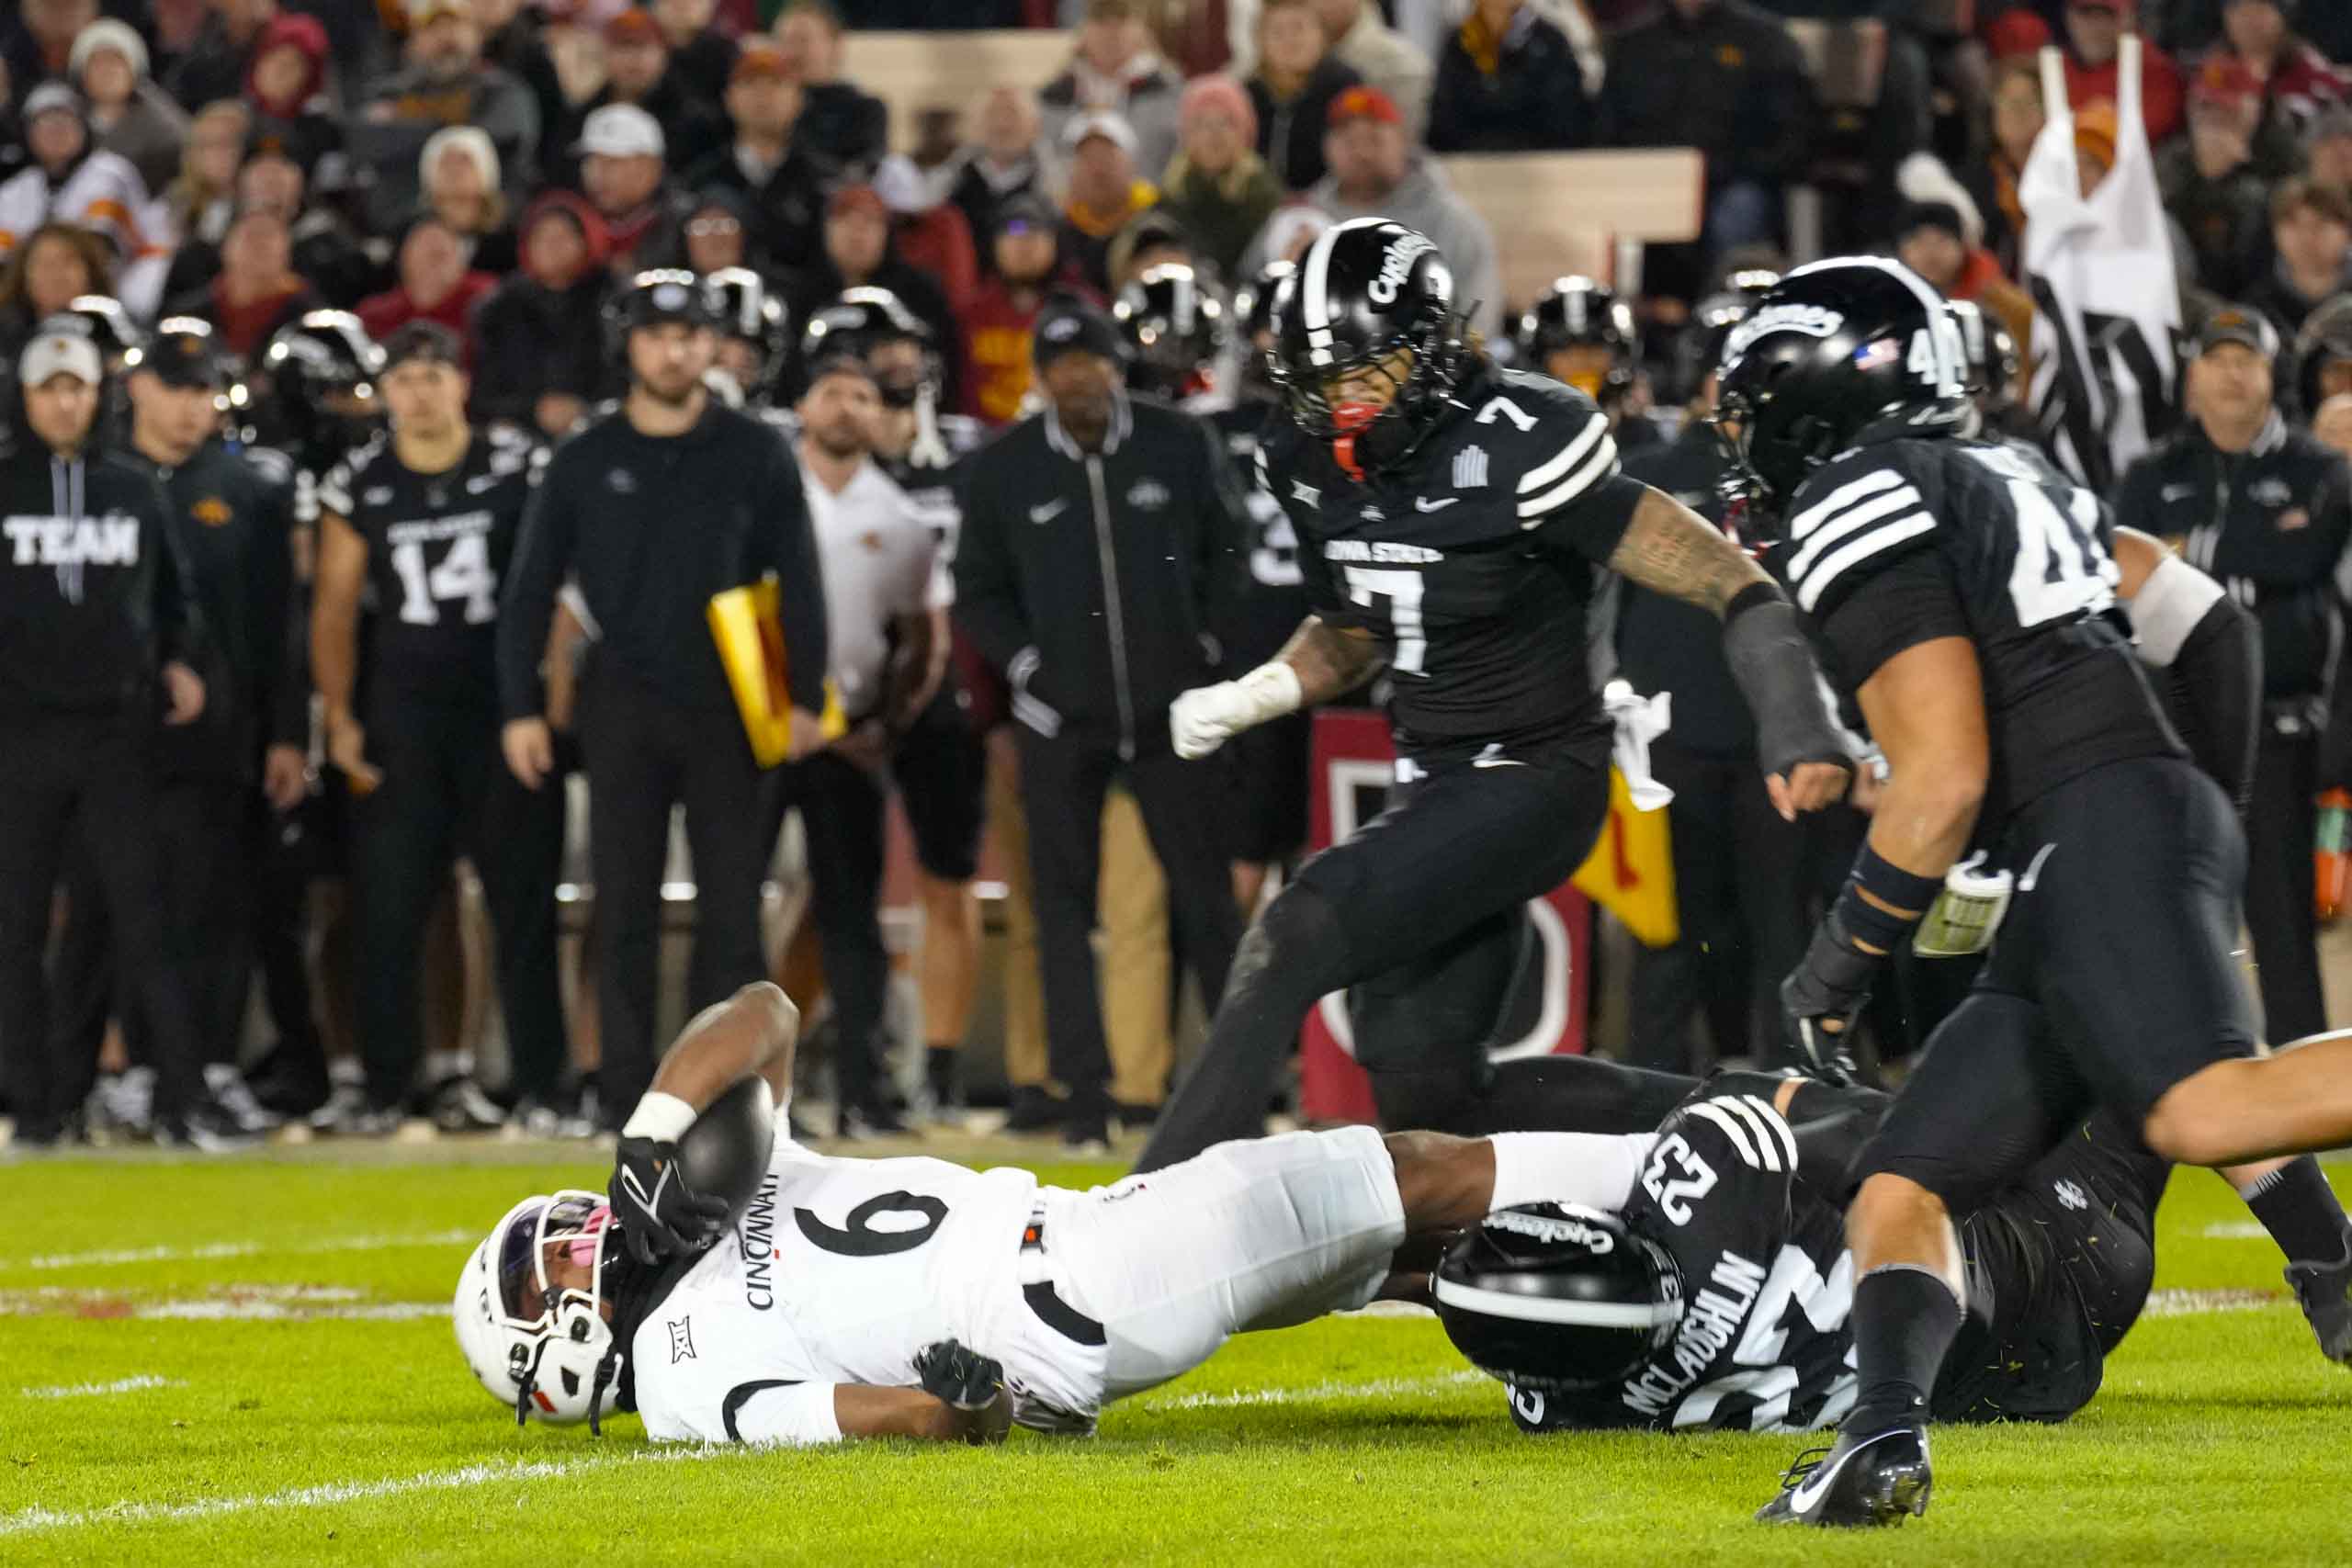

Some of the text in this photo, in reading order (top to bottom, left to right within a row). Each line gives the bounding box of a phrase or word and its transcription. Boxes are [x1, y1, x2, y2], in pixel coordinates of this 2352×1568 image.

[1475, 396, 1540, 432] 7
[2, 514, 140, 566] TEAM
[390, 540, 499, 626] 14
[1343, 565, 1431, 678] 7
[1642, 1133, 1718, 1226] 23
[794, 1190, 949, 1257] 6
